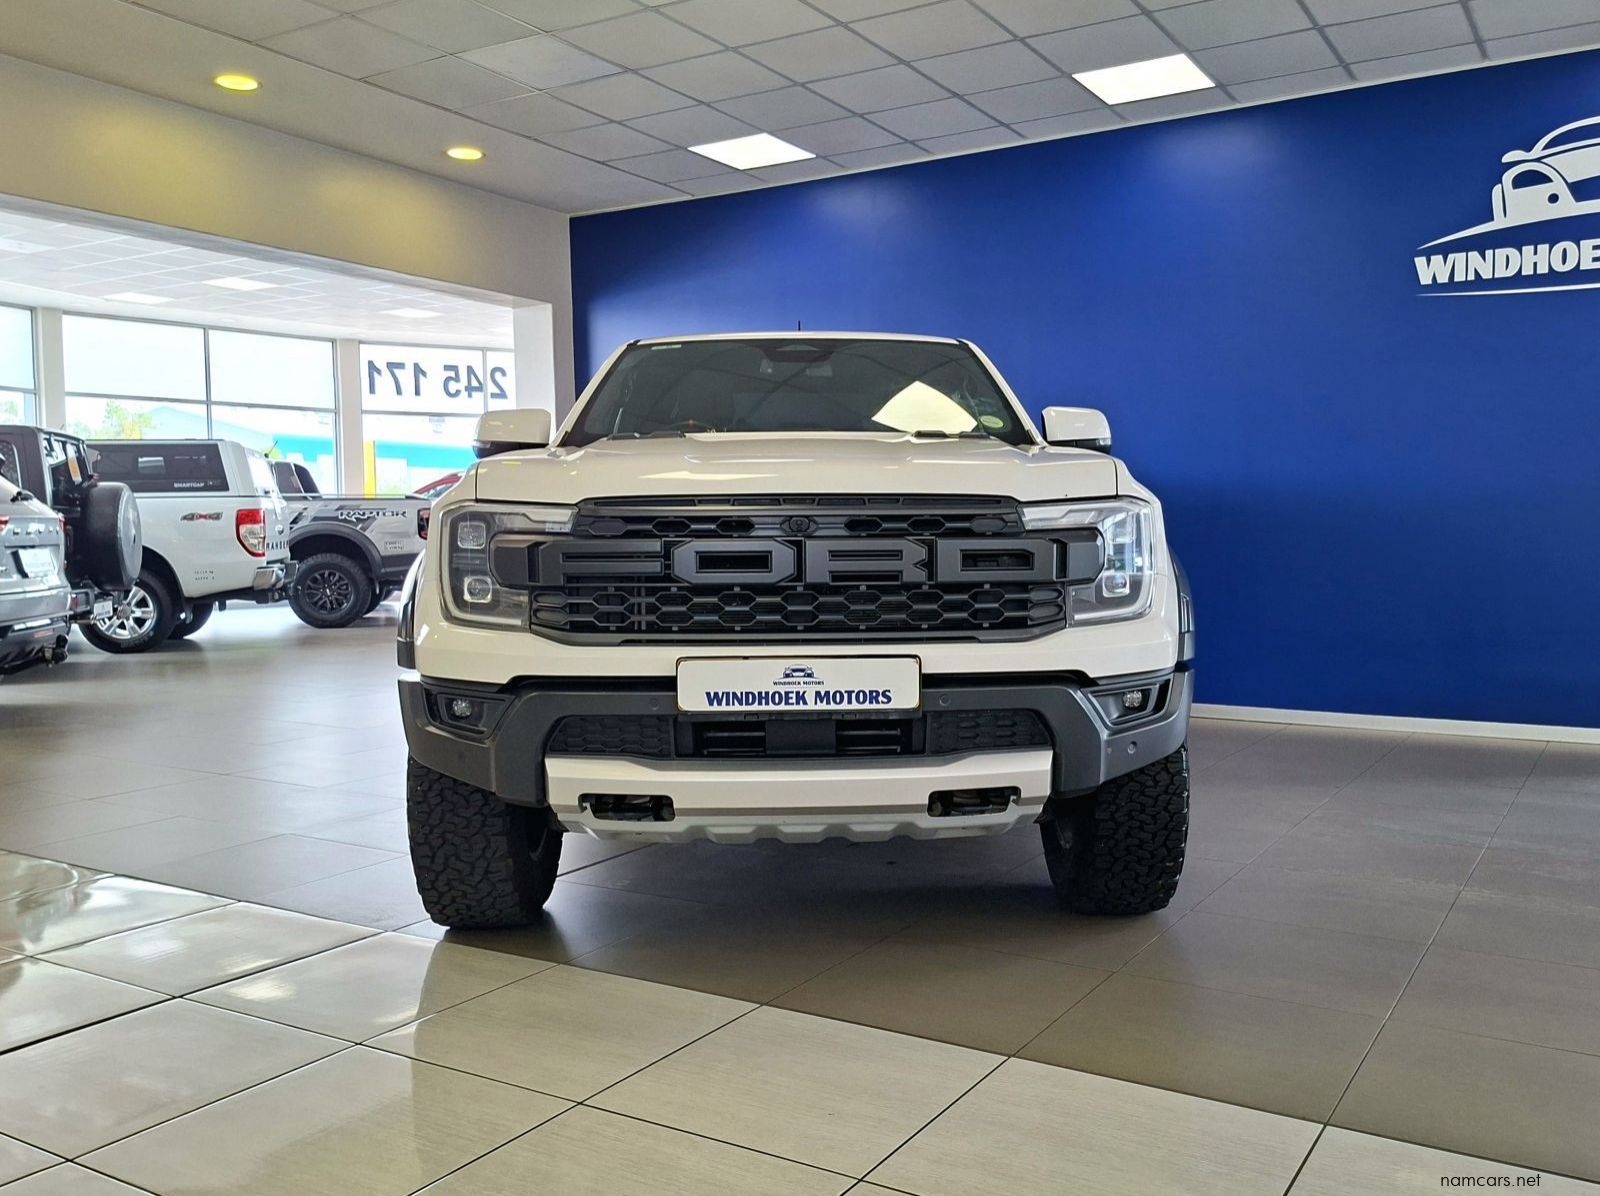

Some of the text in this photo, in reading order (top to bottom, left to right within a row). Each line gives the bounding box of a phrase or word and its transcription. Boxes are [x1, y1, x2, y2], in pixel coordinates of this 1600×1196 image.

[338, 509, 408, 522] RAPTOR
[538, 537, 1056, 585] FORD
[705, 689, 893, 706] WINDHOEK MOTORS
